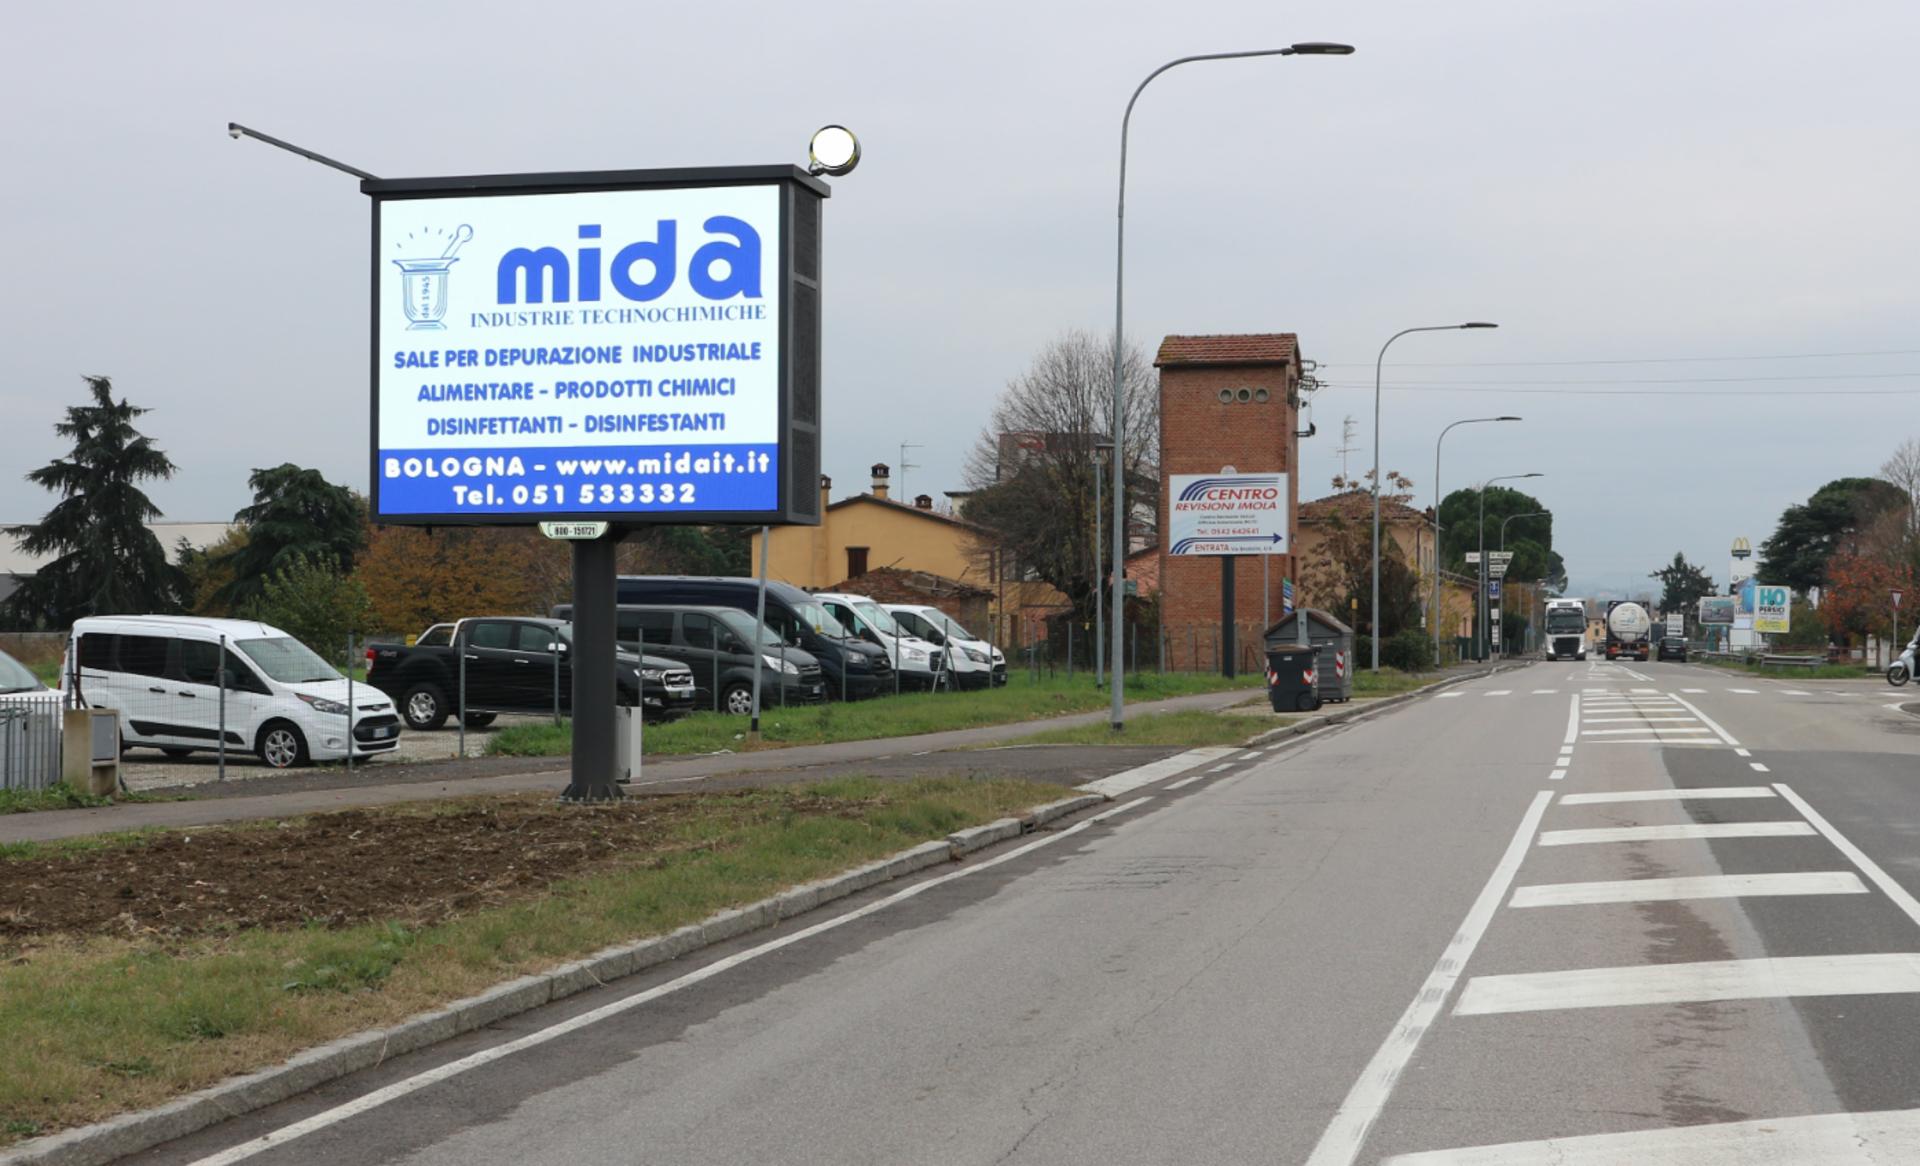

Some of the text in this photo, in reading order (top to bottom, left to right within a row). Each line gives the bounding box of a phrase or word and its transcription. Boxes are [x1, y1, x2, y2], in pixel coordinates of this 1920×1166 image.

[497, 215, 762, 305] mida
[471, 305, 767, 328] INDUSTRIE TECHNOCHIMICHE
[394, 342, 762, 369] SALE PER DEPURAZIONE INDUSTRIALE
[418, 382, 534, 402] ALIMENTARE
[555, 380, 653, 399] PRODOTTI
[658, 378, 736, 398] CHIMICI
[427, 416, 563, 436] DISINFETTANTI
[585, 413, 726, 433] DISINFESTANTI
[385, 456, 526, 478] BOLOGNA
[556, 450, 770, 475] www.midait.it
[453, 483, 695, 505] Tel. 051 533332
[1207, 488, 1278, 500] CENTRO
[1176, 501, 1277, 511] REVISIONI IMOLA
[1195, 544, 1230, 552] ENTRATA
